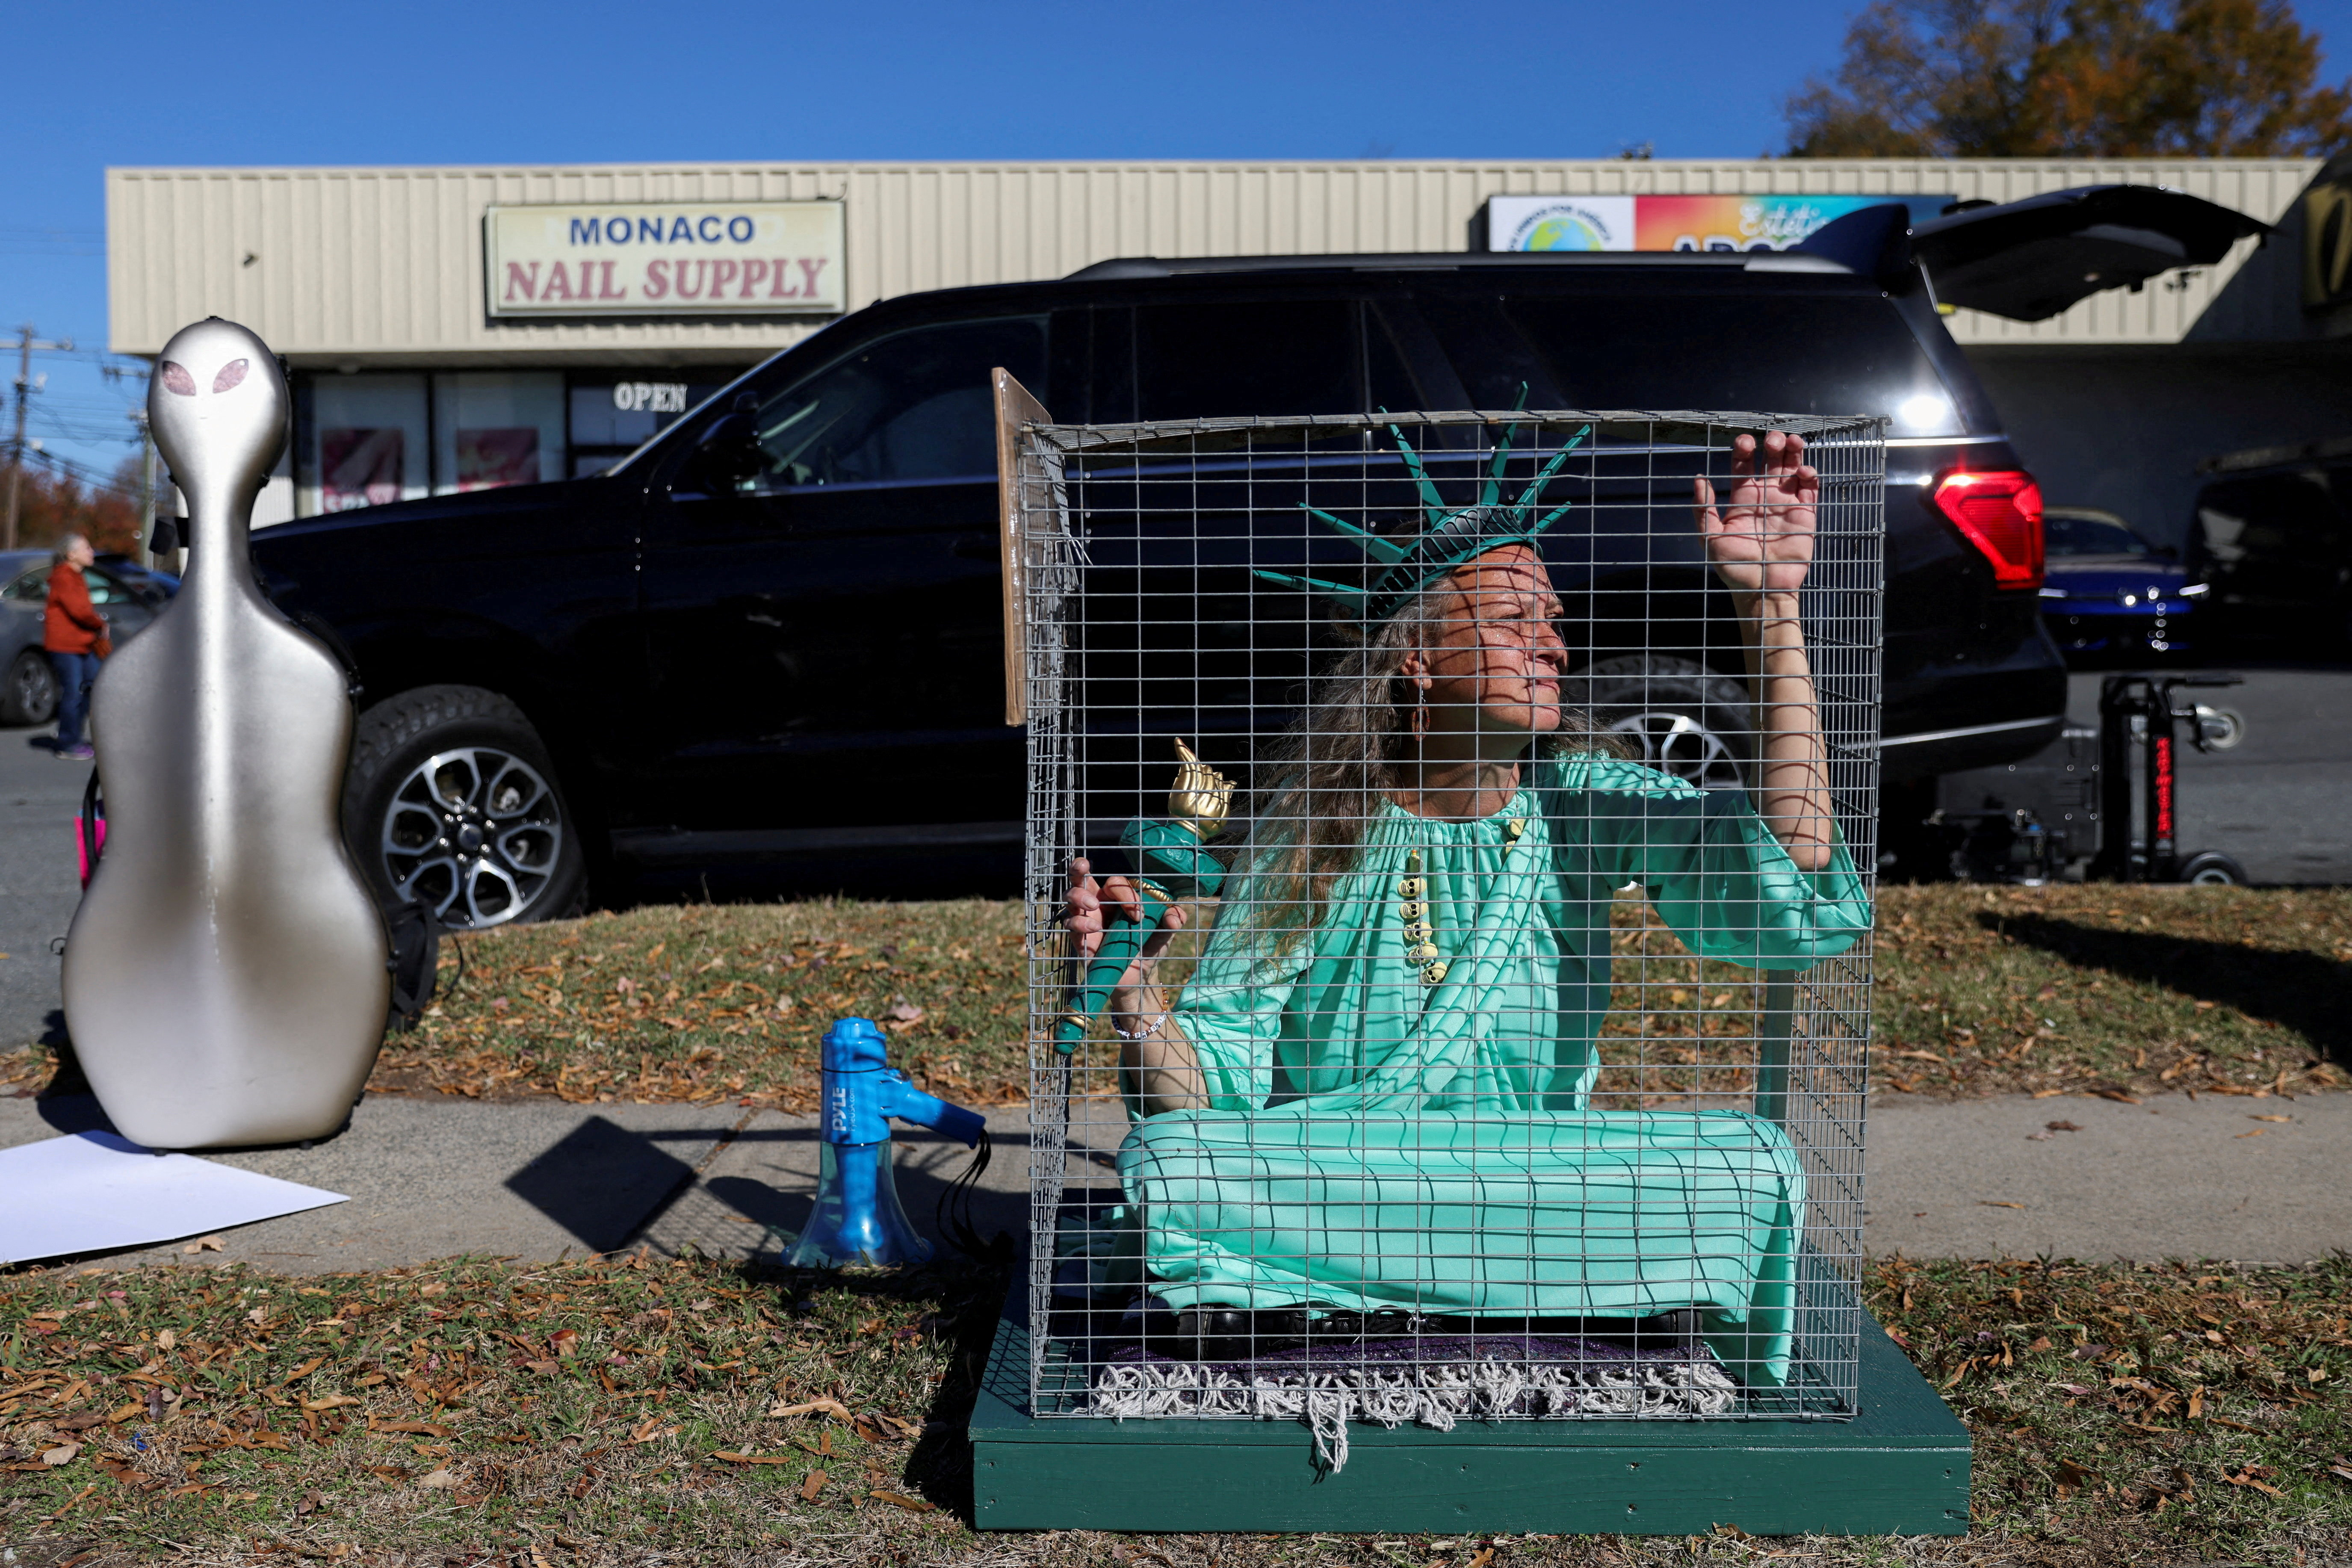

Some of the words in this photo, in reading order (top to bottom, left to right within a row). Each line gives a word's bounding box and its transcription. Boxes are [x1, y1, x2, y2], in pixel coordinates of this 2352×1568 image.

[570, 216, 753, 245] MONACO
[505, 260, 627, 301] NAIL
[643, 258, 828, 300] SUPPLY
[613, 381, 688, 413] OPEN
[833, 1087, 847, 1131] PYLE
[848, 1088, 857, 1131] PyleUSA.com
